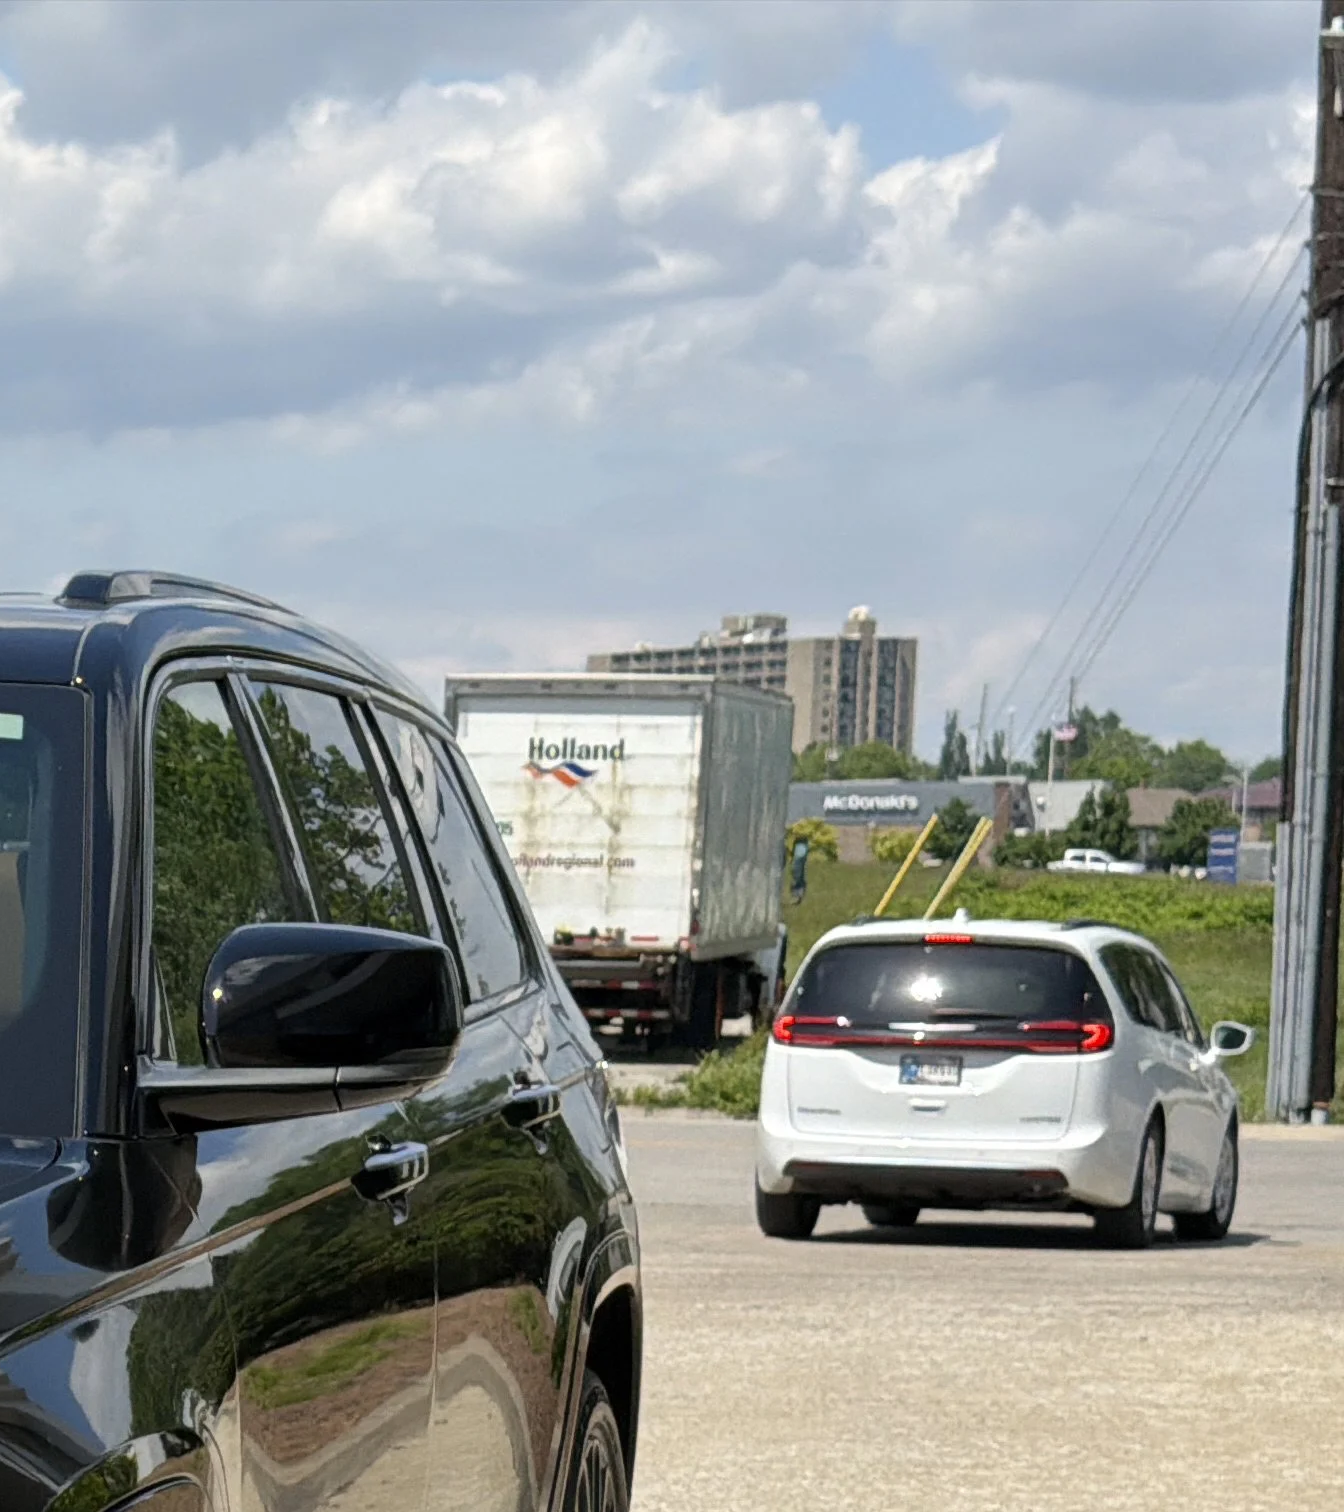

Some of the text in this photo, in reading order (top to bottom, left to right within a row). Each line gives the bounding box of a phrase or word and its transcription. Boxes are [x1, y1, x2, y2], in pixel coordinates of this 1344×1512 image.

[528, 737, 625, 760] Holland
[823, 794, 919, 811] McDonald's
[512, 852, 636, 870] ollandregional.com
